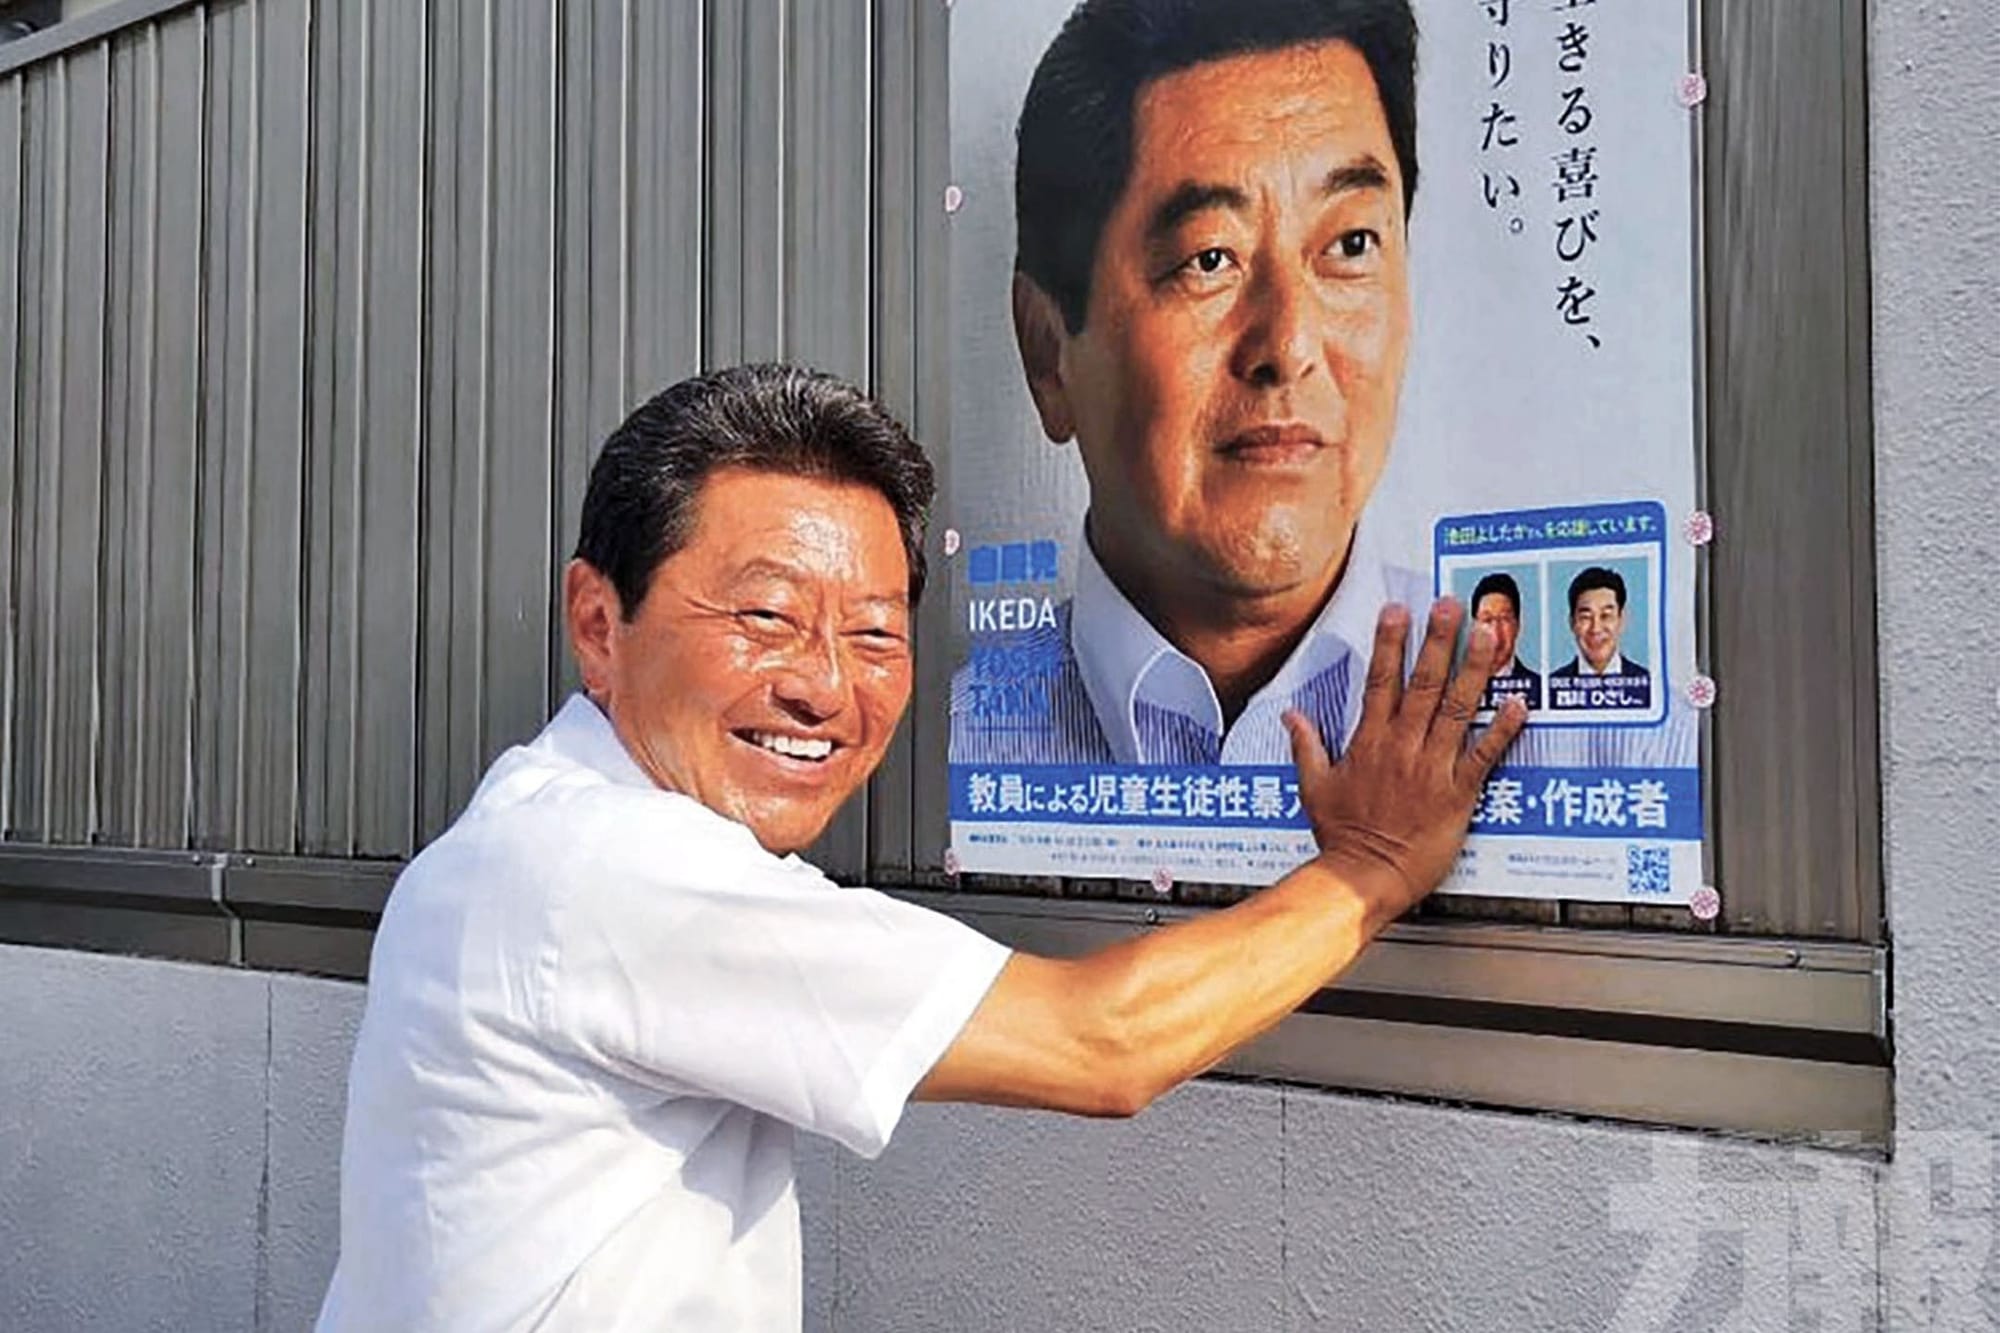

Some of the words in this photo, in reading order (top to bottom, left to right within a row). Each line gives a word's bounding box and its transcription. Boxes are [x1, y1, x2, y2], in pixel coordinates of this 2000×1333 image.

[1552, 0, 1600, 349] きる喜びを、
[968, 597, 1058, 632] IKEDA
